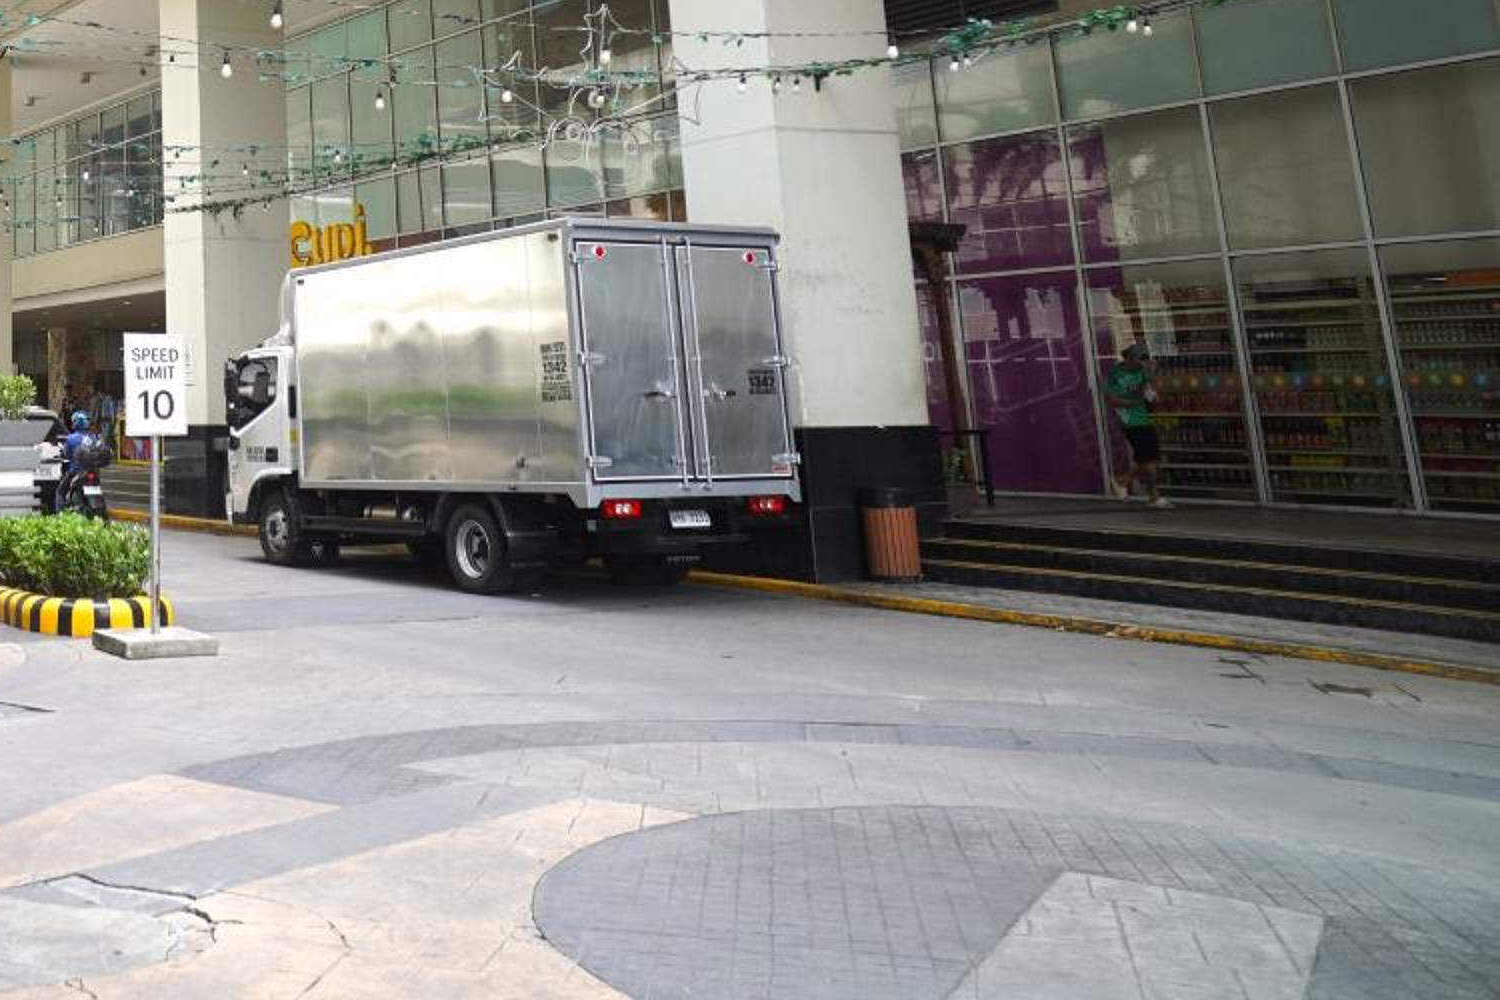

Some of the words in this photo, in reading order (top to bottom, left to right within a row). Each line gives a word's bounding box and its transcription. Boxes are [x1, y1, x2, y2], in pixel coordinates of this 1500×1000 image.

[131, 347, 178, 362] SPEED
[136, 366, 175, 380] LIMIT
[543, 360, 568, 373] 1342
[138, 390, 175, 420] 10
